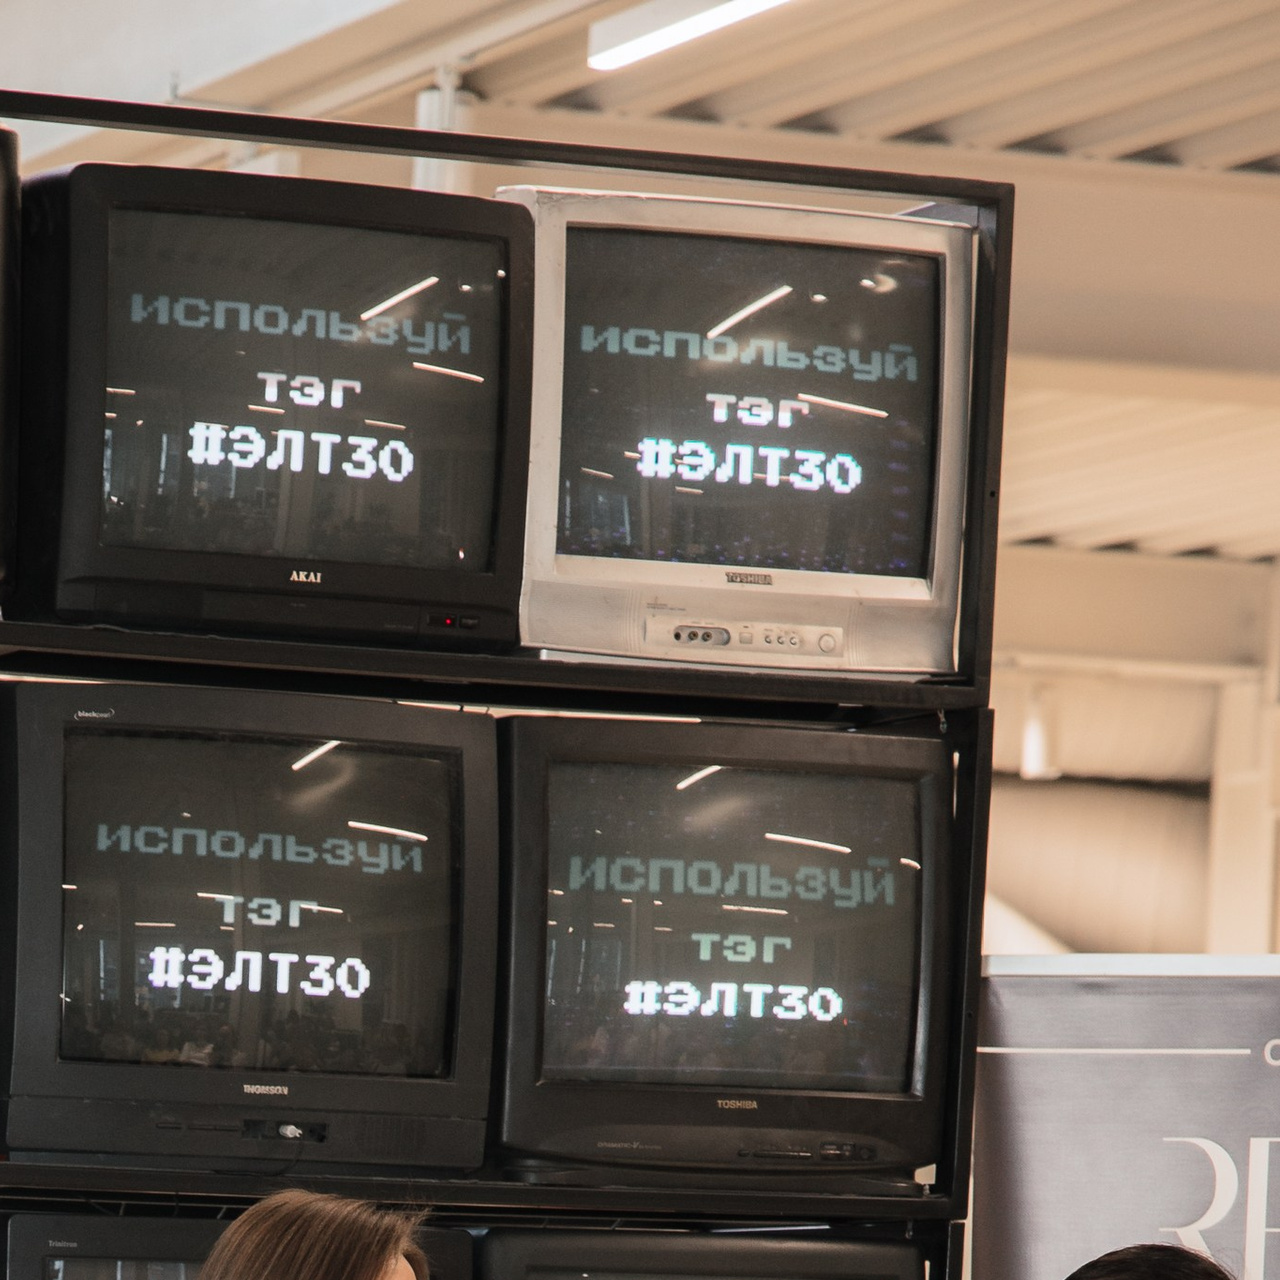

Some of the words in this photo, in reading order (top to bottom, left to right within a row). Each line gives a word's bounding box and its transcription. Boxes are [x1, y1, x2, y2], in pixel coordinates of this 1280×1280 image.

[289, 570, 322, 583] AKAI
[725, 571, 773, 585] TOSHIBA
[243, 1084, 289, 1095] THOMSON
[717, 1100, 758, 1109] TOSHIBA
